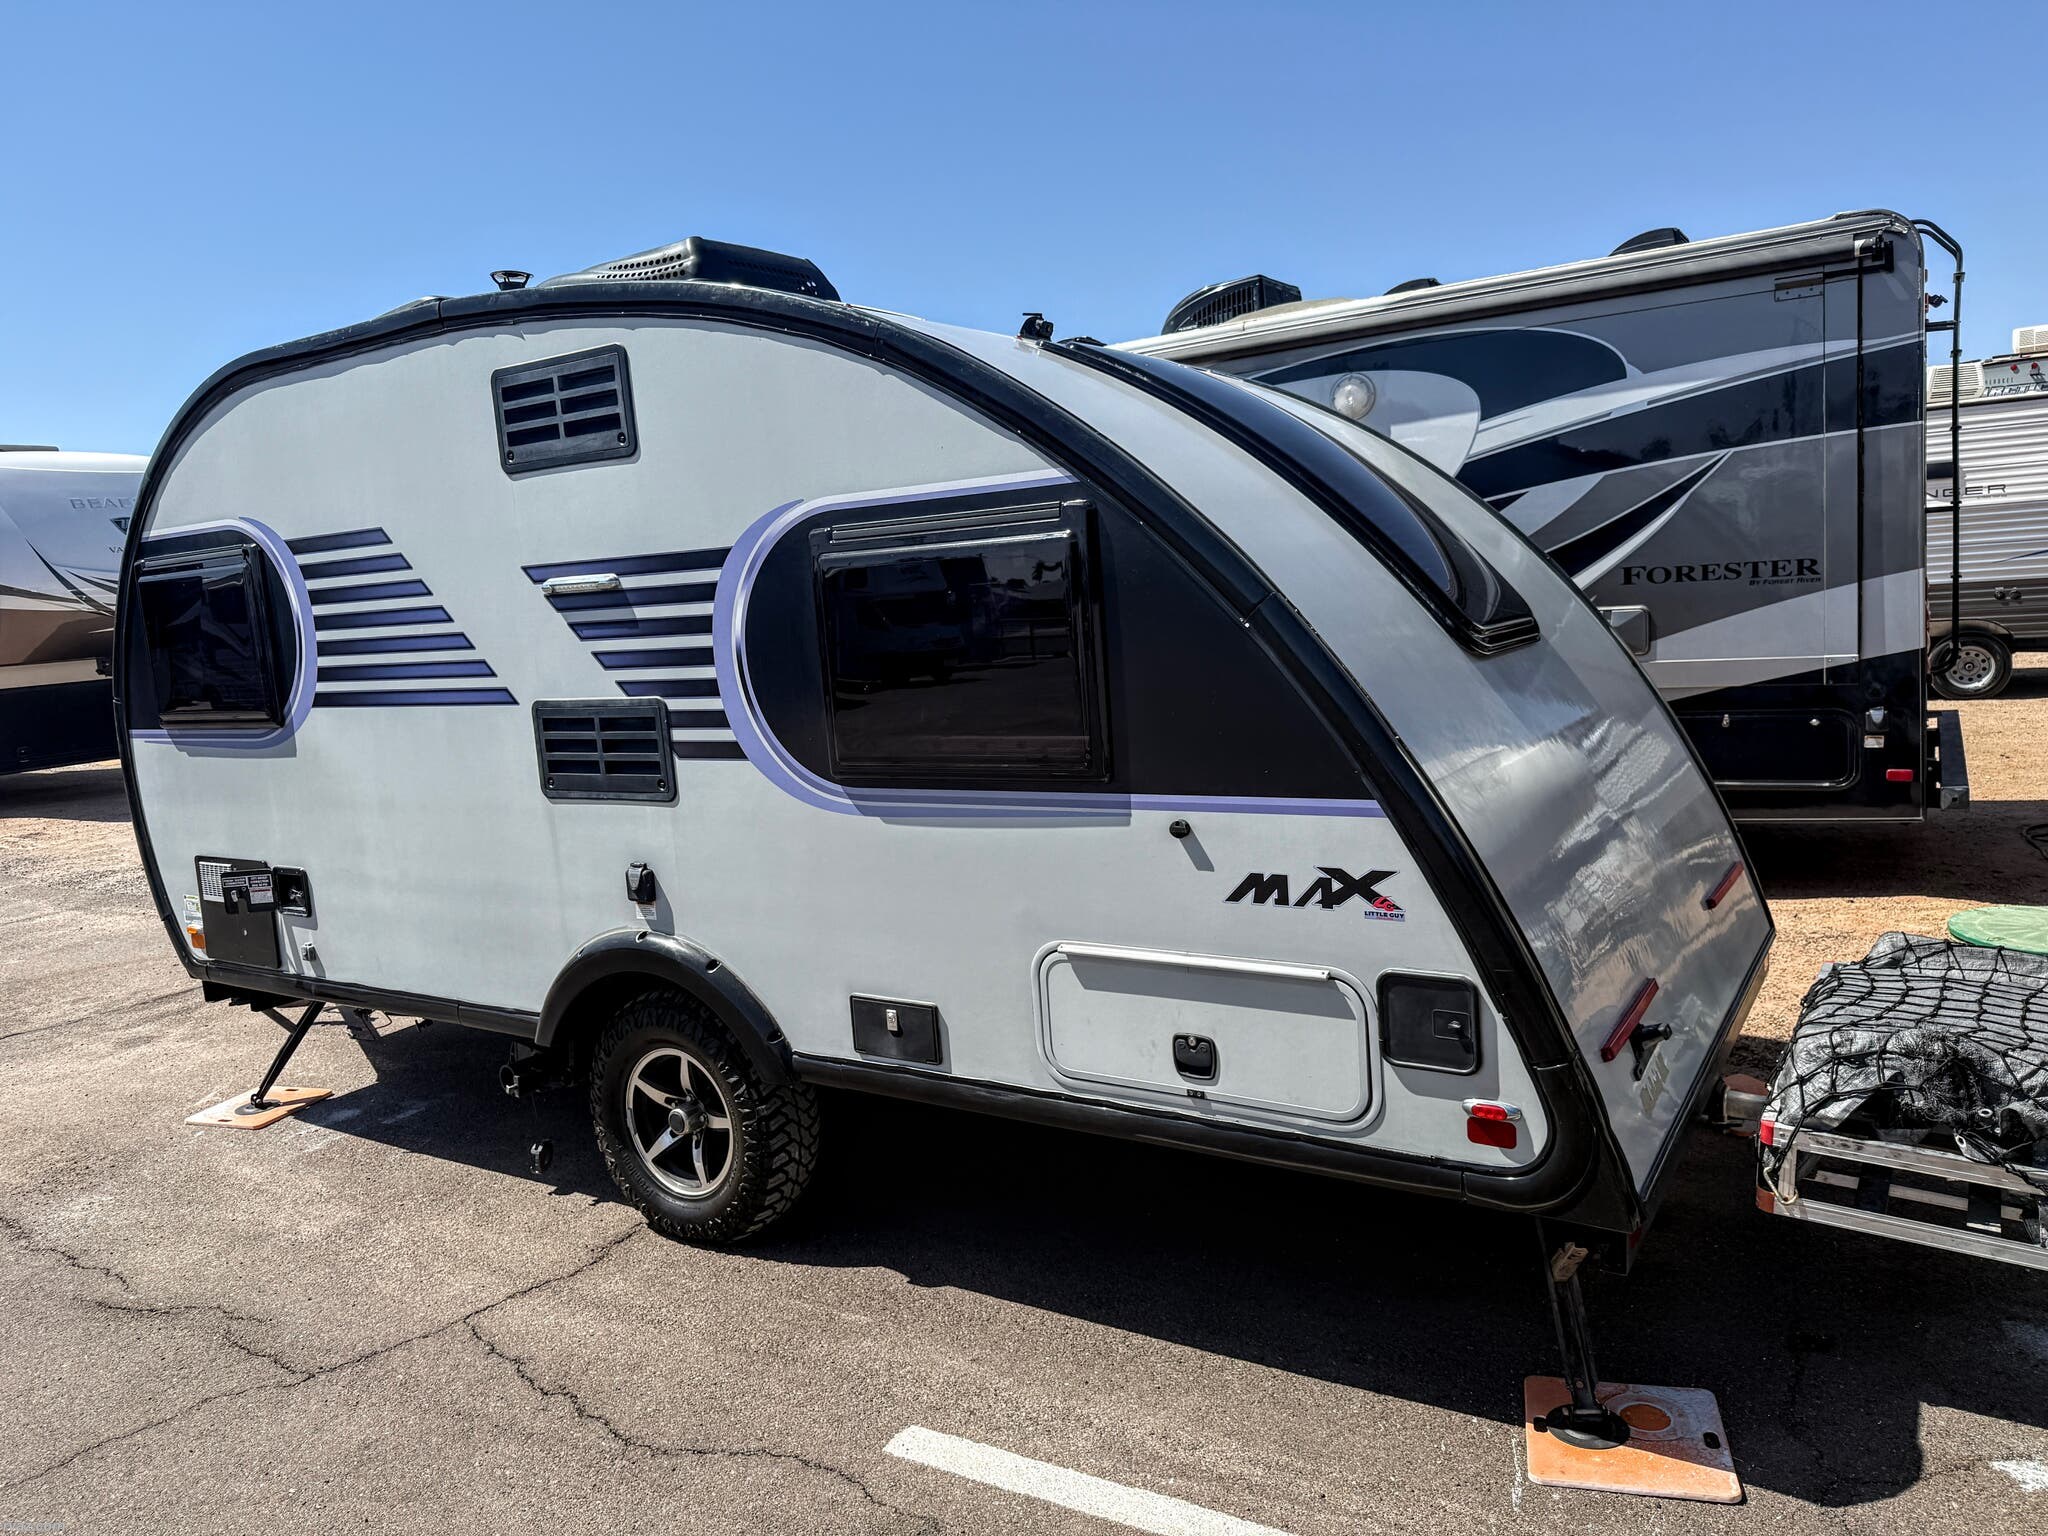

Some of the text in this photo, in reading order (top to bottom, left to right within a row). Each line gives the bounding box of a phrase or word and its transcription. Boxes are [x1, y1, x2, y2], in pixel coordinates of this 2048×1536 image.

[1620, 558, 1821, 586] FORESTER
[1223, 866, 1405, 911] MAX
[1364, 910, 1388, 918] LITTLE
